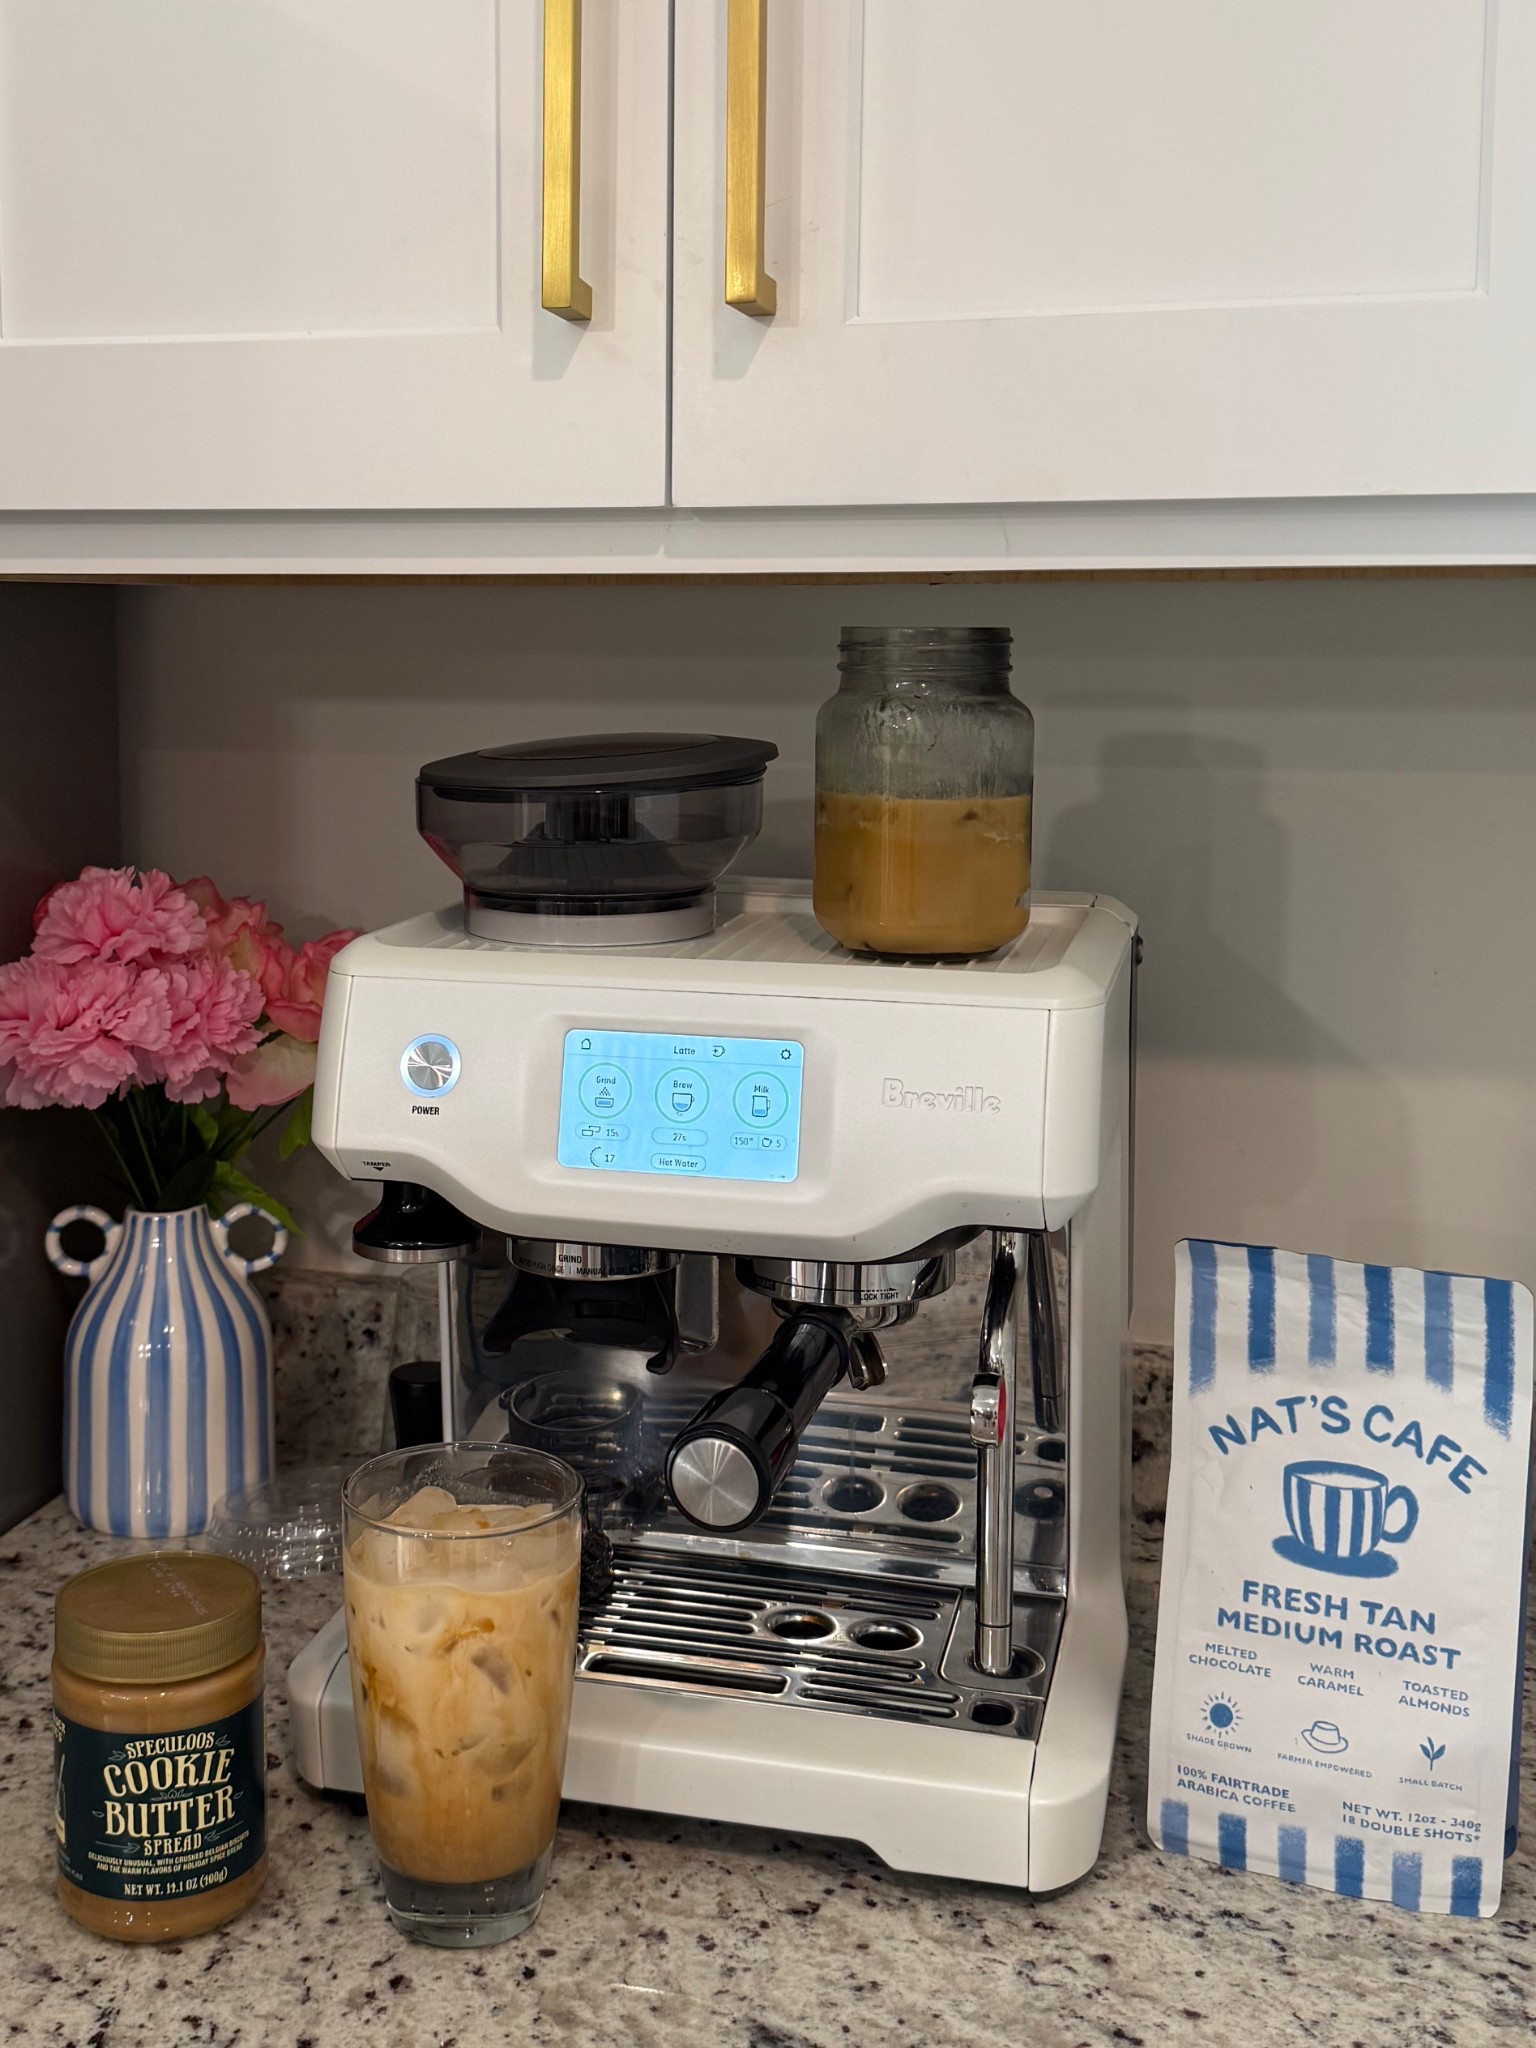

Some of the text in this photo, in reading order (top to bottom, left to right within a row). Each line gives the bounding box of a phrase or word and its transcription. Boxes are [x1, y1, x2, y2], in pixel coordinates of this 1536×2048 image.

[673, 1045, 696, 1056] Latte
[596, 1075, 616, 1085] Grind
[673, 1080, 693, 1090] Brew
[753, 1084, 770, 1094] Milk
[881, 1077, 1002, 1115] Breville
[411, 1105, 440, 1116] POWER
[672, 1132, 687, 1142] 27s
[604, 1154, 616, 1164] 17
[658, 1157, 699, 1169] Hot Water
[558, 1253, 583, 1264] GRIND
[576, 1267, 608, 1276] MANUAL
[880, 1291, 899, 1300] TIGHT
[1208, 1394, 1488, 1495] NAT'S CAFE
[1242, 1579, 1436, 1635] FRESH TAN
[1216, 1607, 1462, 1670] MEDIUM ROAST
[1204, 1642, 1258, 1661] MELTED
[1188, 1653, 1272, 1679] CHOCOLATE
[1309, 1662, 1355, 1680] WARM
[1297, 1674, 1365, 1697] CARAMEL
[1402, 1680, 1469, 1702] TOASTED
[1398, 1694, 1471, 1718] ALMONDS
[124, 1731, 216, 1760] SPECULOOS
[1186, 1732, 1252, 1754] SHADE GROWN
[103, 1748, 235, 1798] COOKIE
[1277, 1752, 1373, 1779] FARMER EMPOWERED
[1176, 1764, 1291, 1800] 100% FAIRTRADE
[1398, 1776, 1464, 1792] SMALL BATCH
[1176, 1778, 1297, 1814] ARABICA COFFEE
[103, 1784, 236, 1838] BUTTER
[1342, 1800, 1372, 1817] NET
[1375, 1806, 1403, 1823] WT.
[1407, 1812, 1438, 1825] 12oz
[1449, 1816, 1482, 1833] 340g
[1342, 1813, 1357, 1826] 18
[1359, 1817, 1421, 1838] DOUBLE
[87, 1851, 123, 1866] DELICIOUSLY
[156, 1857, 174, 1867] WITH
[174, 1852, 204, 1864] CRUSHED
[204, 1842, 229, 1857] BELGIAN
[143, 1832, 202, 1857] SPREAD
[96, 1843, 243, 1876] AND THE WARM FLAVORS OF HOLIDAY SPICE BREAD
[124, 1883, 143, 1896] NET
[145, 1883, 164, 1896] WT.
[185, 1876, 198, 1891] OZ
